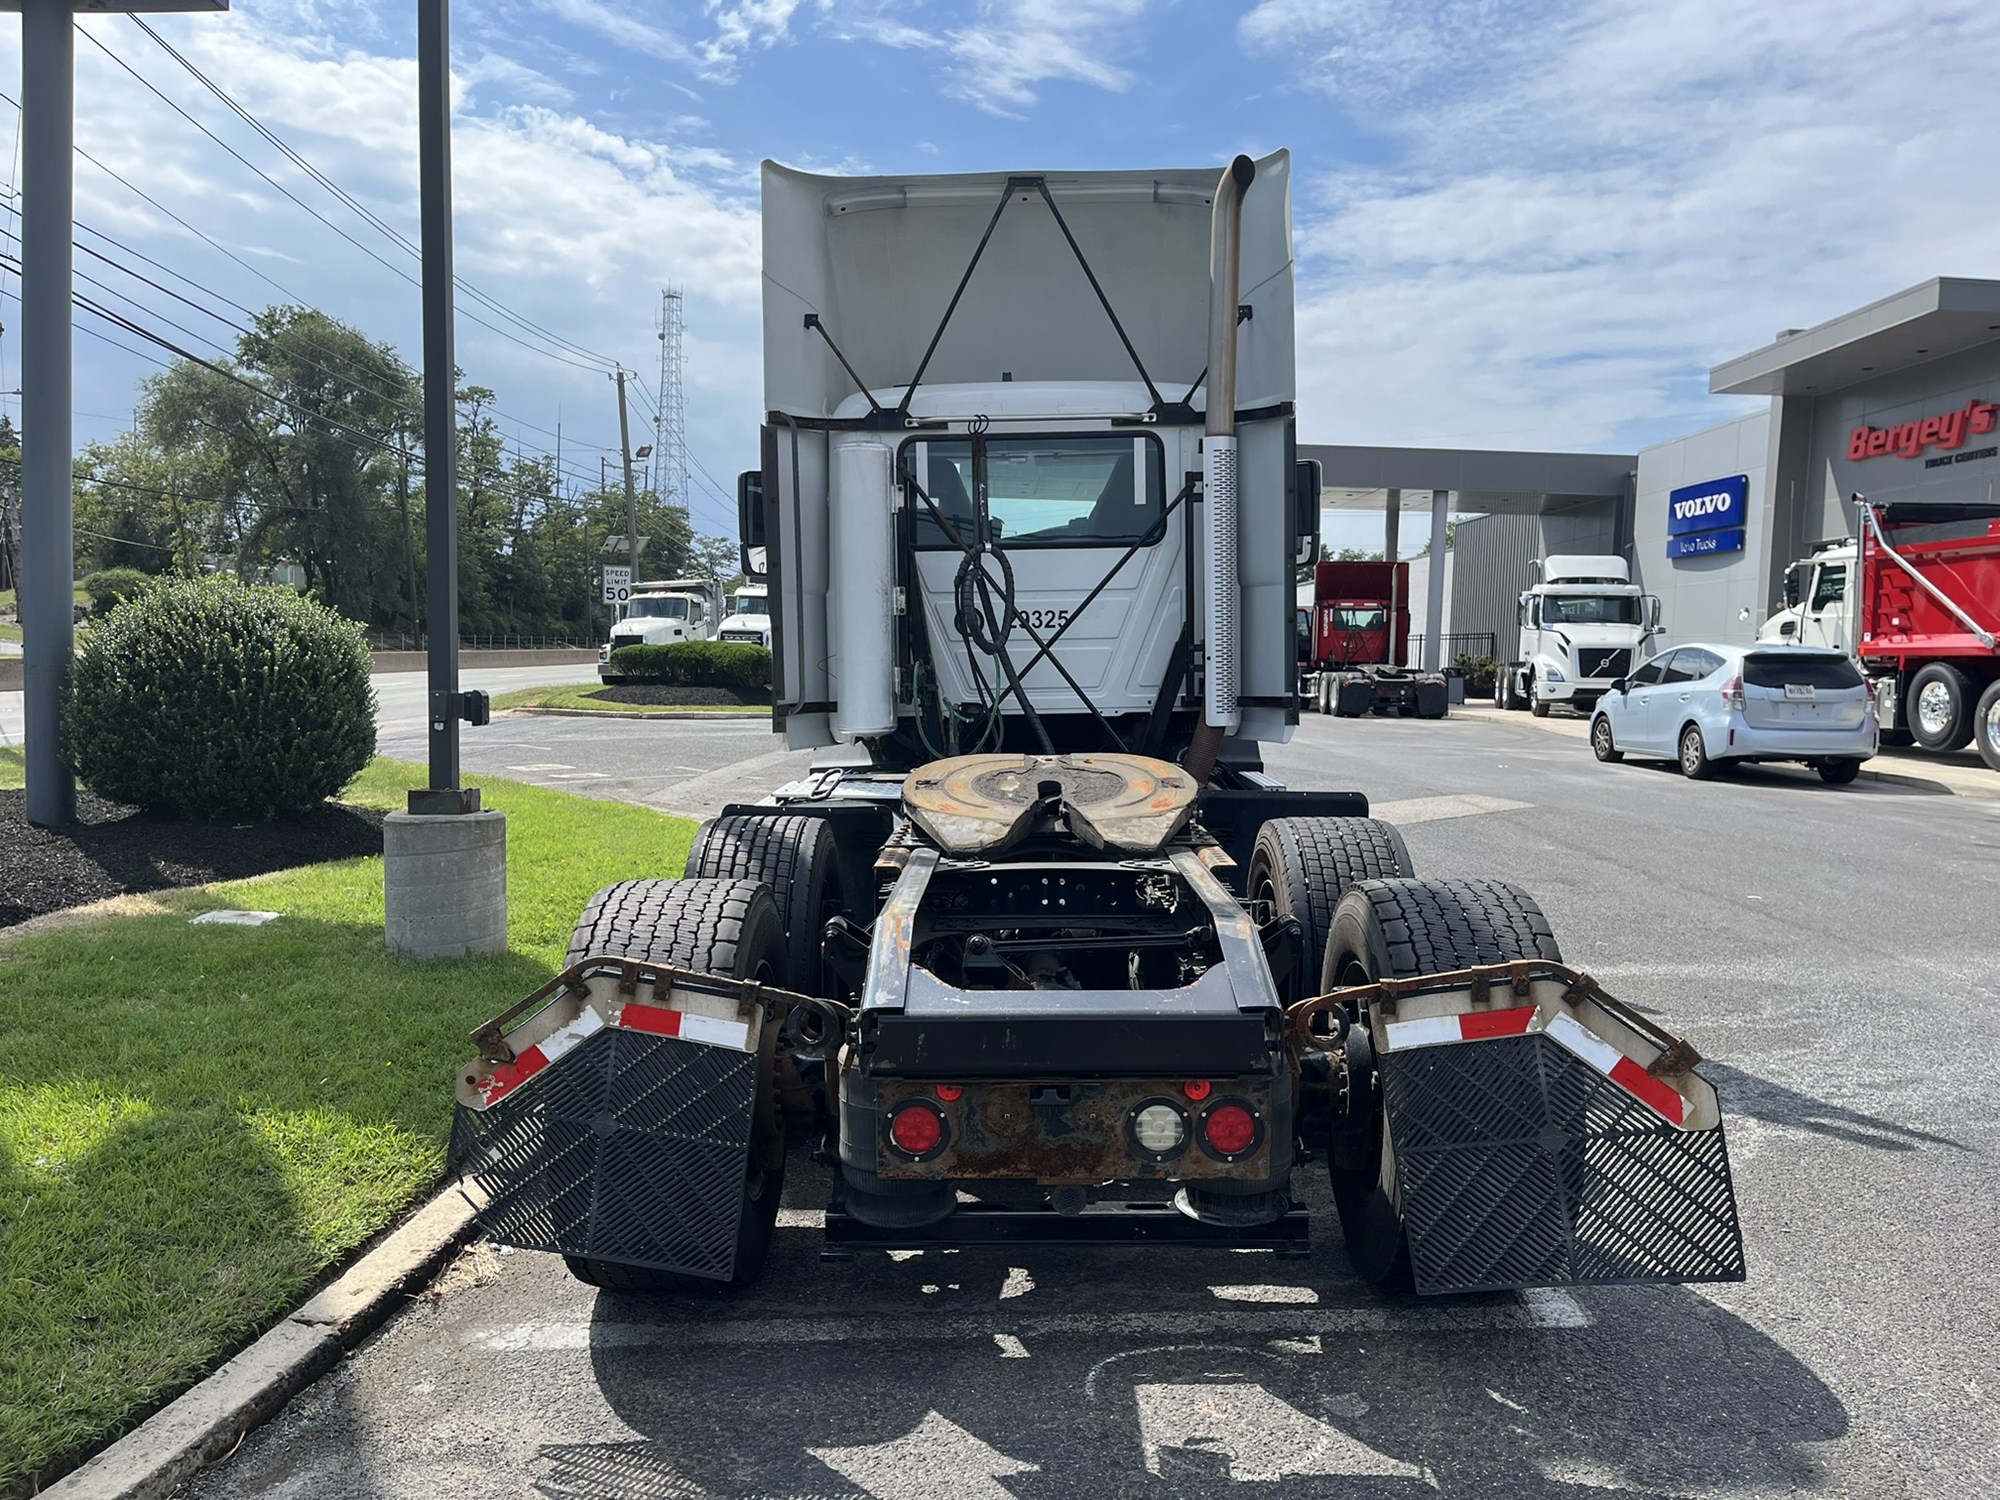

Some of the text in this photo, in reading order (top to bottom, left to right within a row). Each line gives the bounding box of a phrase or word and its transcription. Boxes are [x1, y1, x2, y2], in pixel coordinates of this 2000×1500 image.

[1846, 398, 1999, 462] Bergey's
[1674, 492, 1731, 520] VOLVO
[1696, 538, 1717, 550] Trucks
[606, 587, 629, 601] 50
